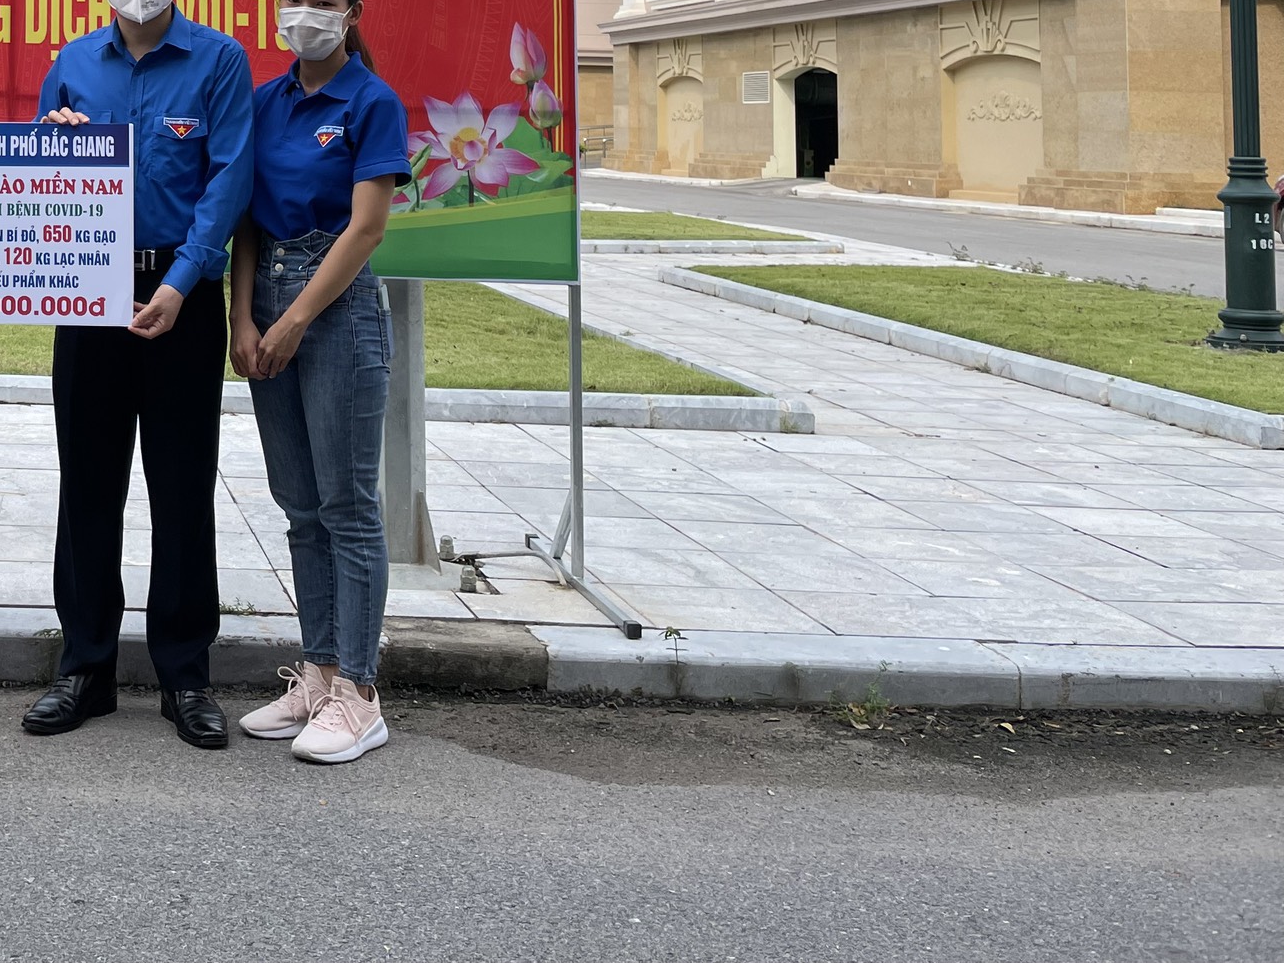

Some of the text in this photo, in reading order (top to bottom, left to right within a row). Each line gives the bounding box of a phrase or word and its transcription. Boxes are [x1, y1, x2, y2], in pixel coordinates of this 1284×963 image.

[11, 128, 37, 156] PHỐ
[42, 128, 68, 156] BẮC
[73, 136, 114, 157] GIANG
[30, 171, 76, 194] MIỀN
[82, 179, 123, 195] NAM
[7, 202, 40, 216] BỆNH
[45, 203, 103, 216] COVID-19
[1255, 213, 1269, 223] L2
[7, 227, 17, 242] BÍ
[21, 225, 39, 244] ĐỎ,
[43, 225, 71, 242] 650
[76, 230, 90, 243] KG
[94, 230, 116, 246] GẠO
[4, 247, 32, 265] 120
[36, 252, 50, 265] KG
[54, 253, 74, 268] LẠC
[79, 249, 109, 265] NHÂN
[13, 270, 45, 288] PHẨM
[49, 273, 79, 288] KHÁC
